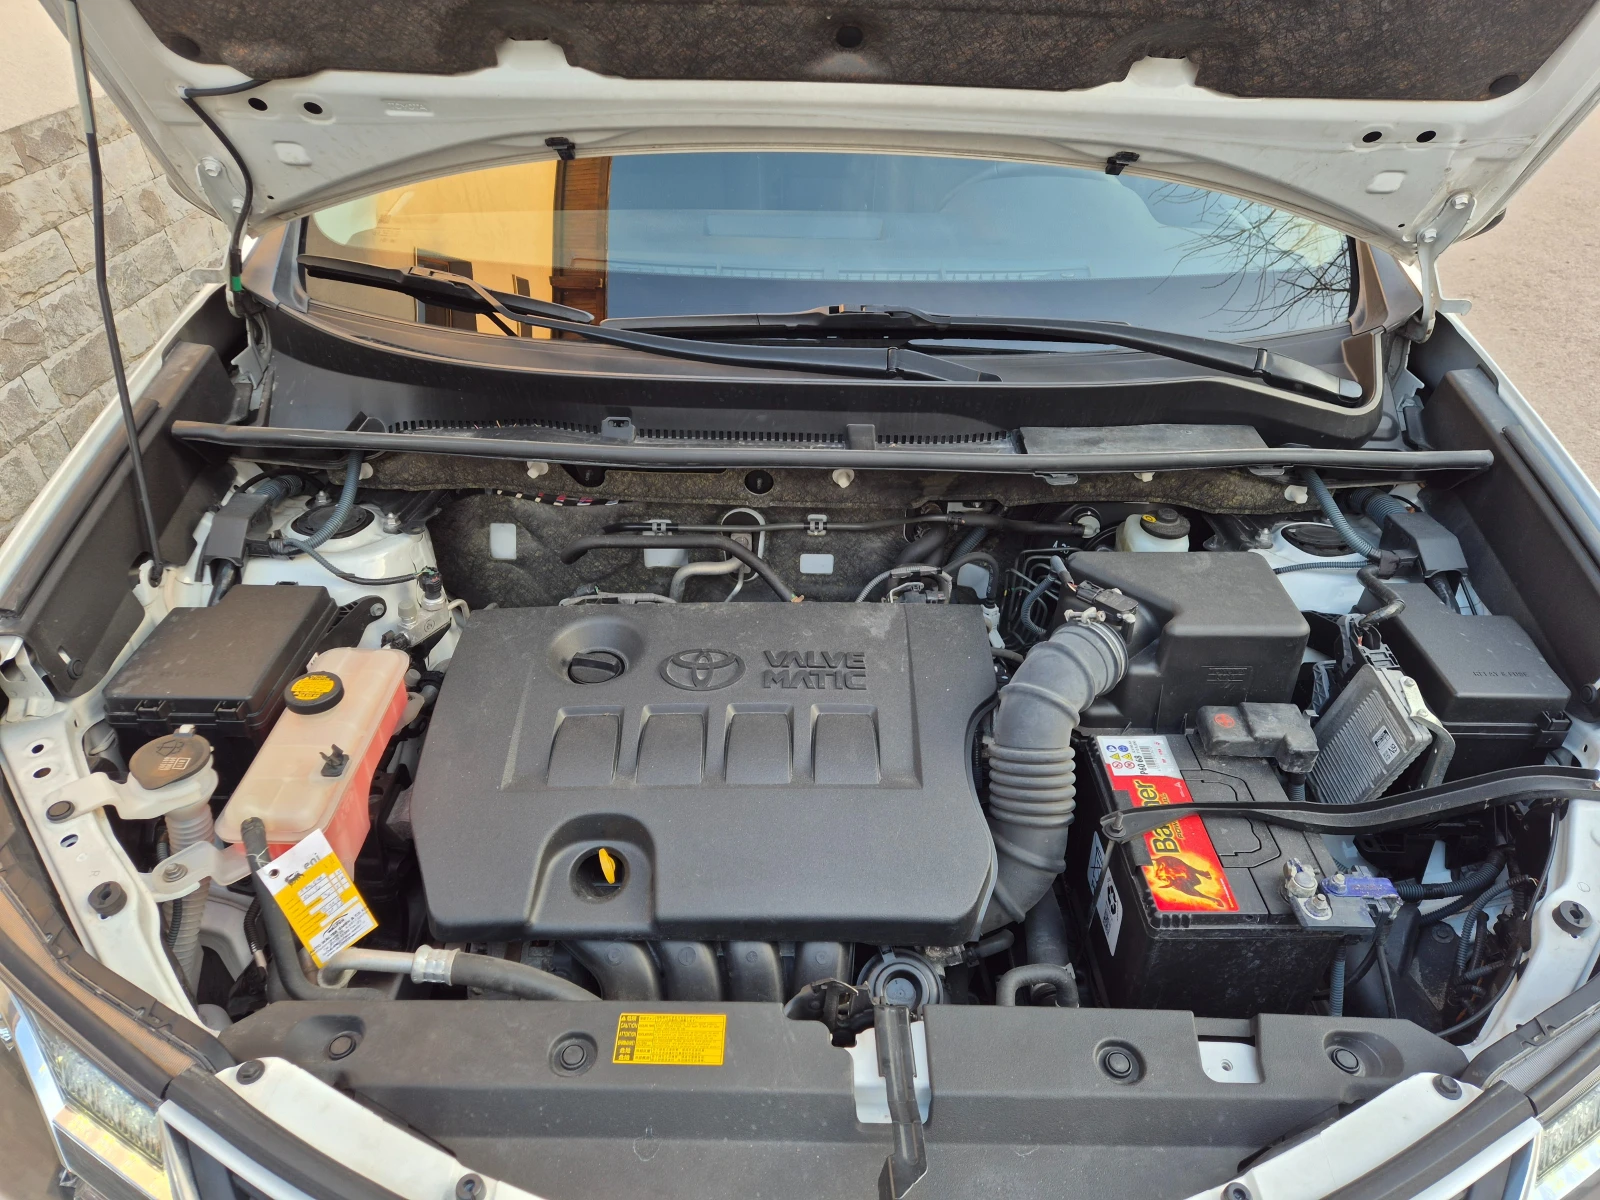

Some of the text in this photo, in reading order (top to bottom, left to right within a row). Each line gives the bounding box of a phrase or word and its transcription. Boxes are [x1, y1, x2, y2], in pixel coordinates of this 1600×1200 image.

[763, 650, 866, 669] VALVE
[763, 669, 867, 690] MATIC
[1133, 780, 1181, 854] Baner
[303, 852, 321, 871] eni
